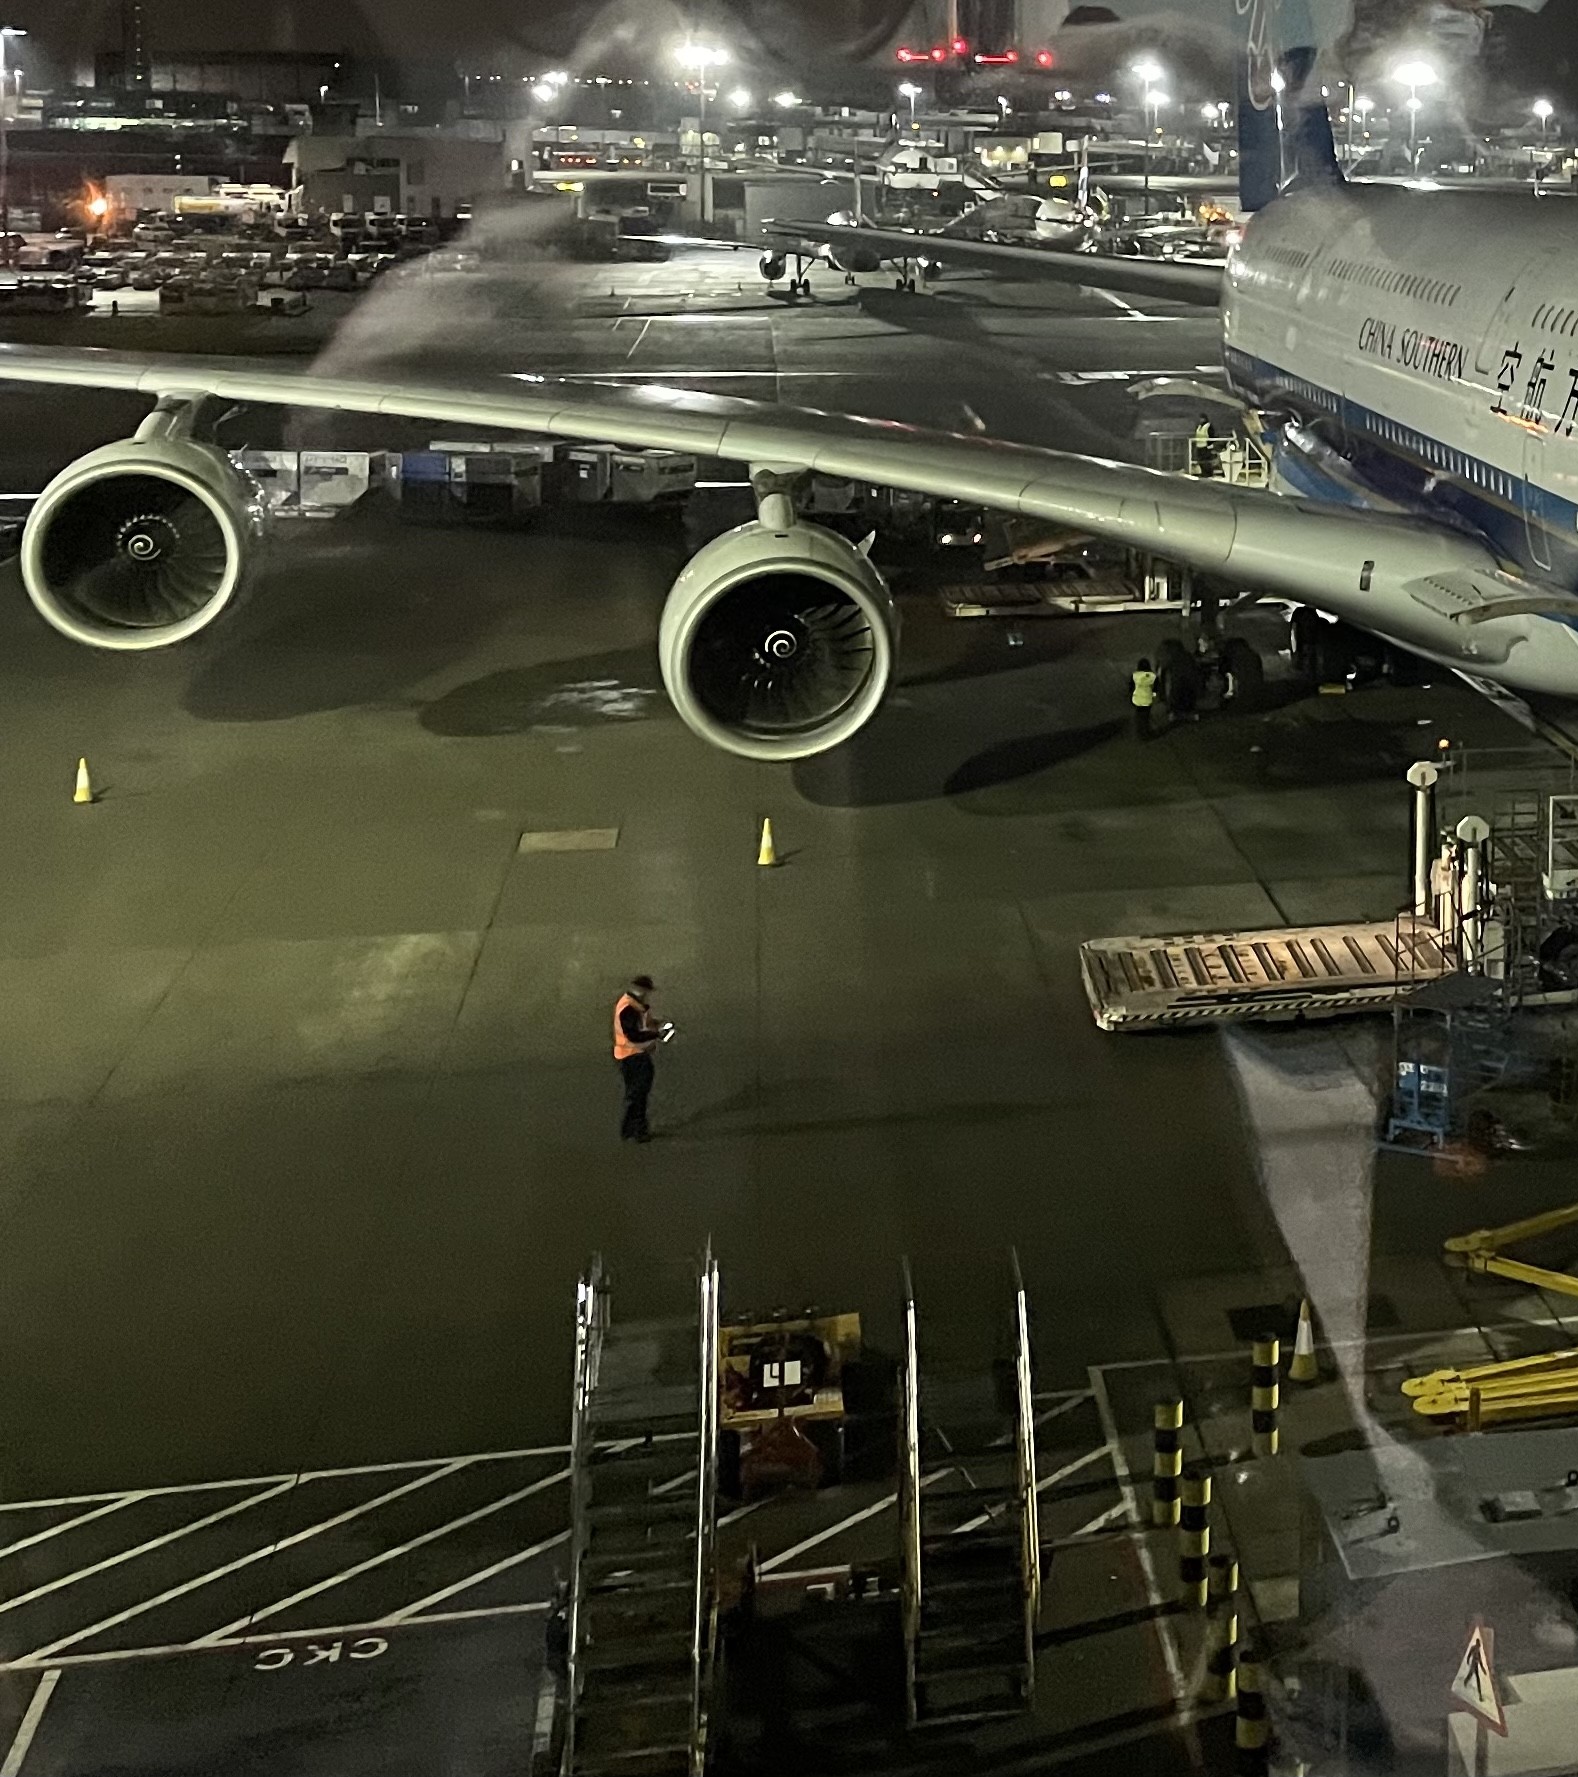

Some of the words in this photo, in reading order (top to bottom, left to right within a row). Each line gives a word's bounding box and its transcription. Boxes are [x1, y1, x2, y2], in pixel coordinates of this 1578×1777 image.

[1358, 316, 1394, 358] CHINA
[1398, 329, 1469, 379] SOUTHERN
[253, 1637, 389, 1670] CKC
